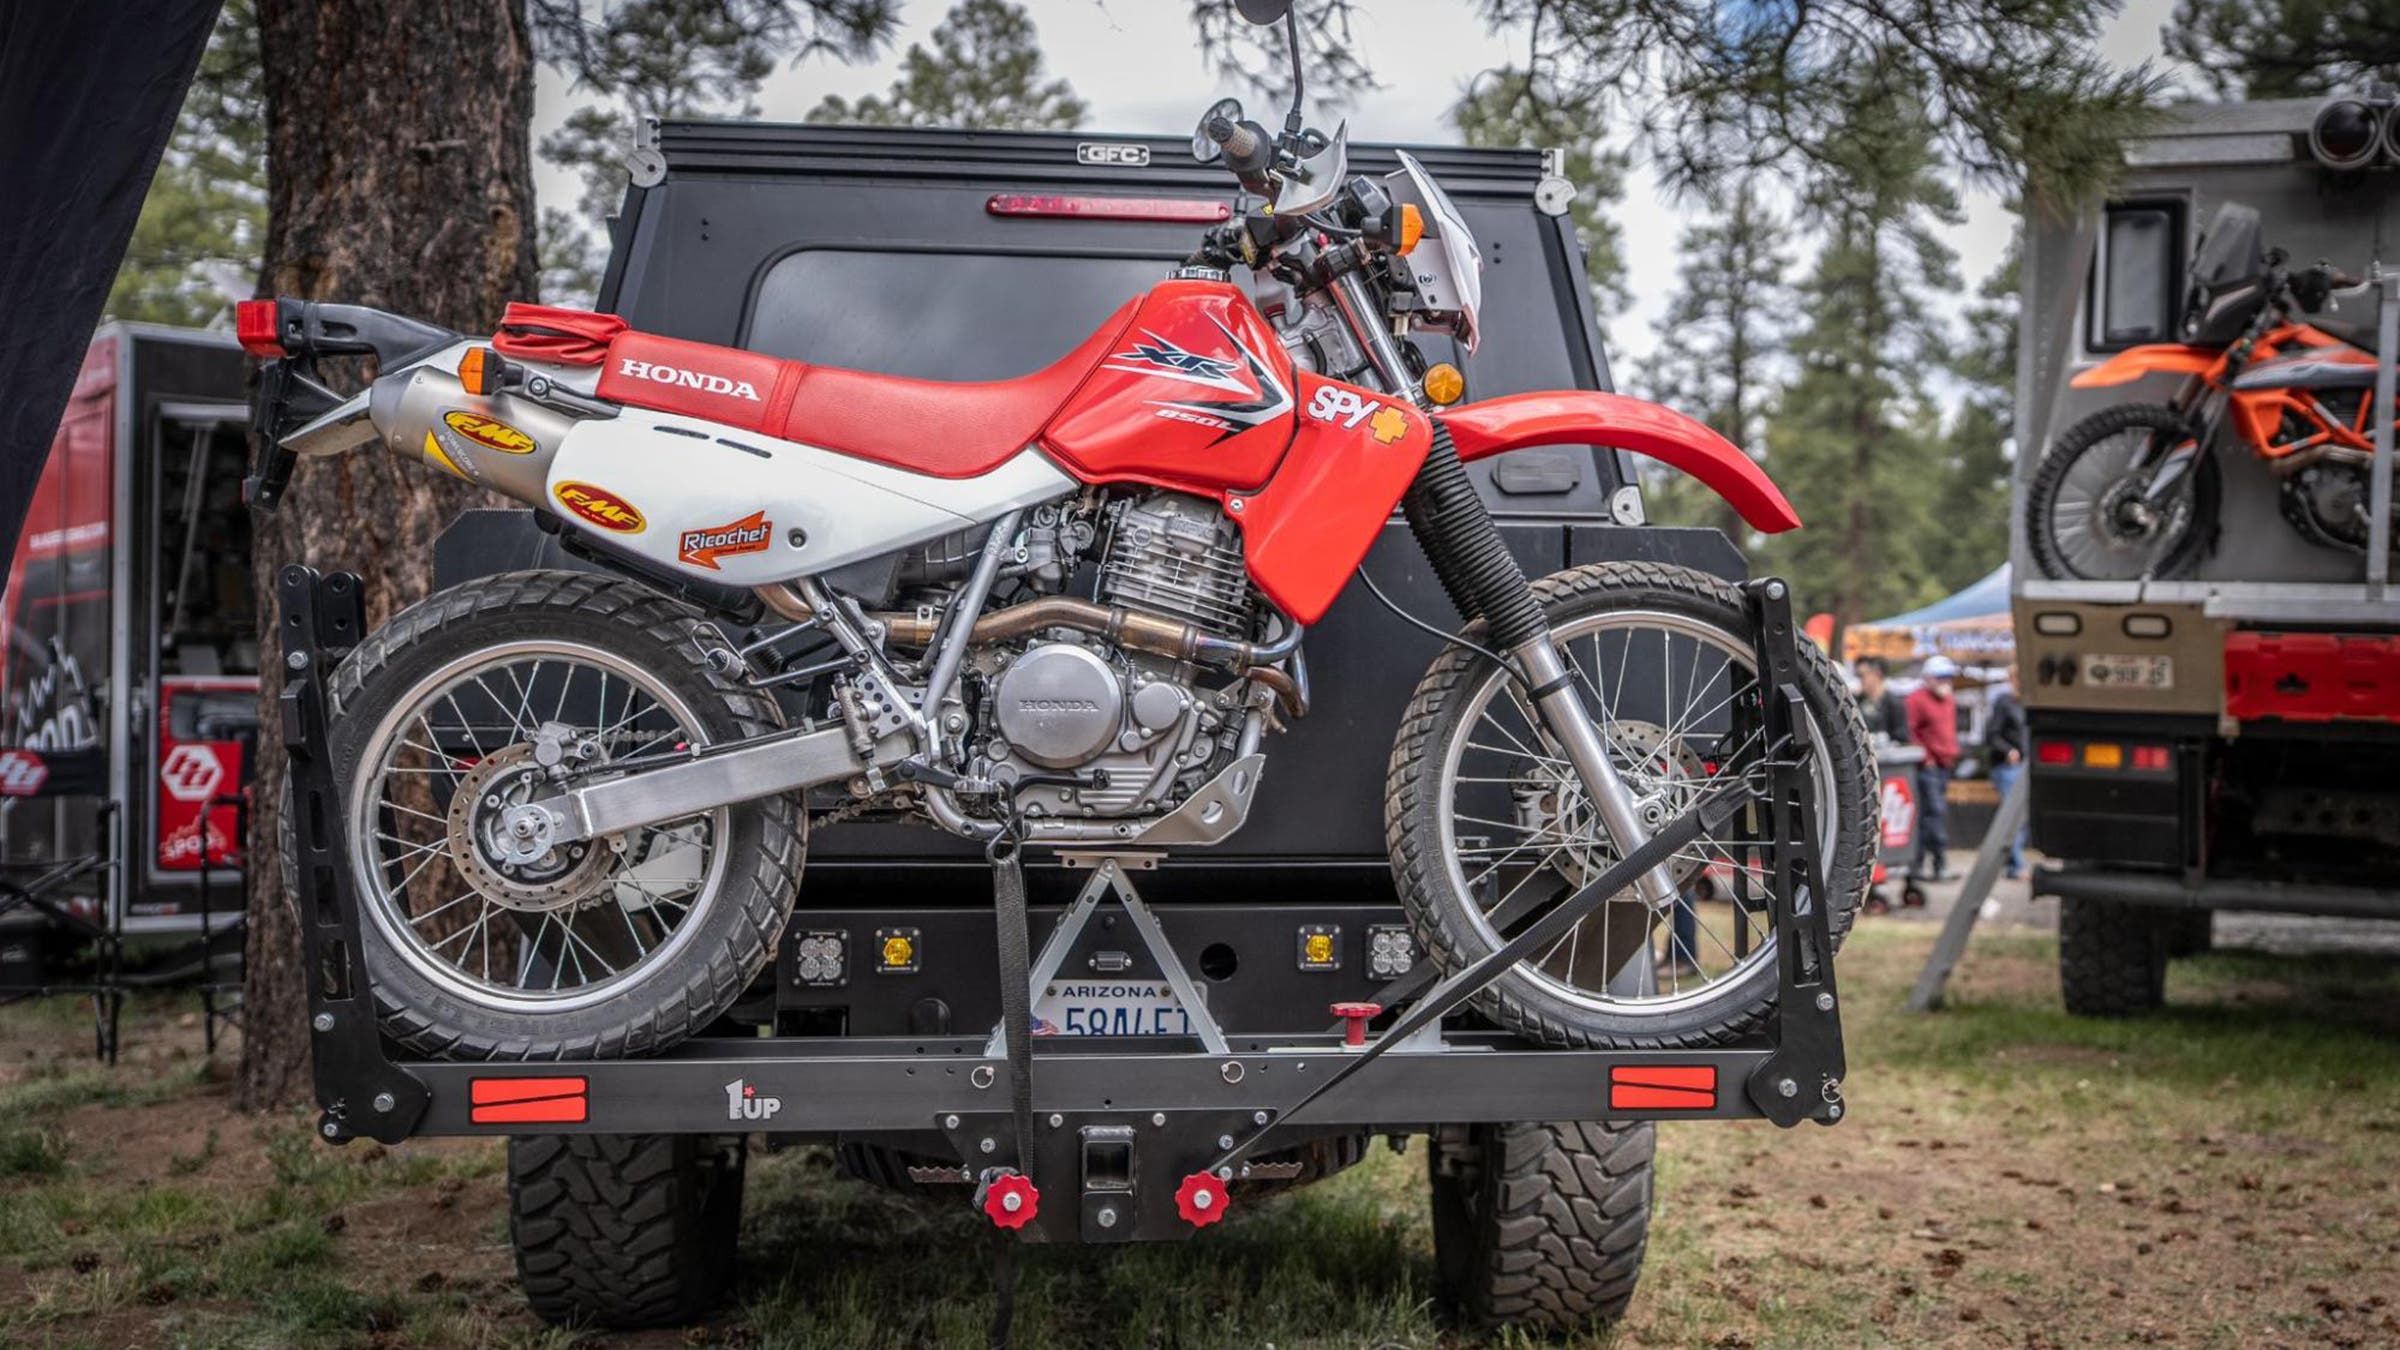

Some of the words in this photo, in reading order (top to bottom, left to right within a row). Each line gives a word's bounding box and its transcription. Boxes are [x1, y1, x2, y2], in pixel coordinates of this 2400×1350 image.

[1087, 146, 1139, 162] GFC
[1109, 327, 1240, 380] XR
[619, 358, 761, 401] HONDA
[446, 411, 536, 449] FMF
[558, 488, 642, 527] FMF
[683, 524, 769, 550] Ricochet
[1018, 699, 1100, 712] HONDA
[1062, 986, 1157, 998] ARIZONA
